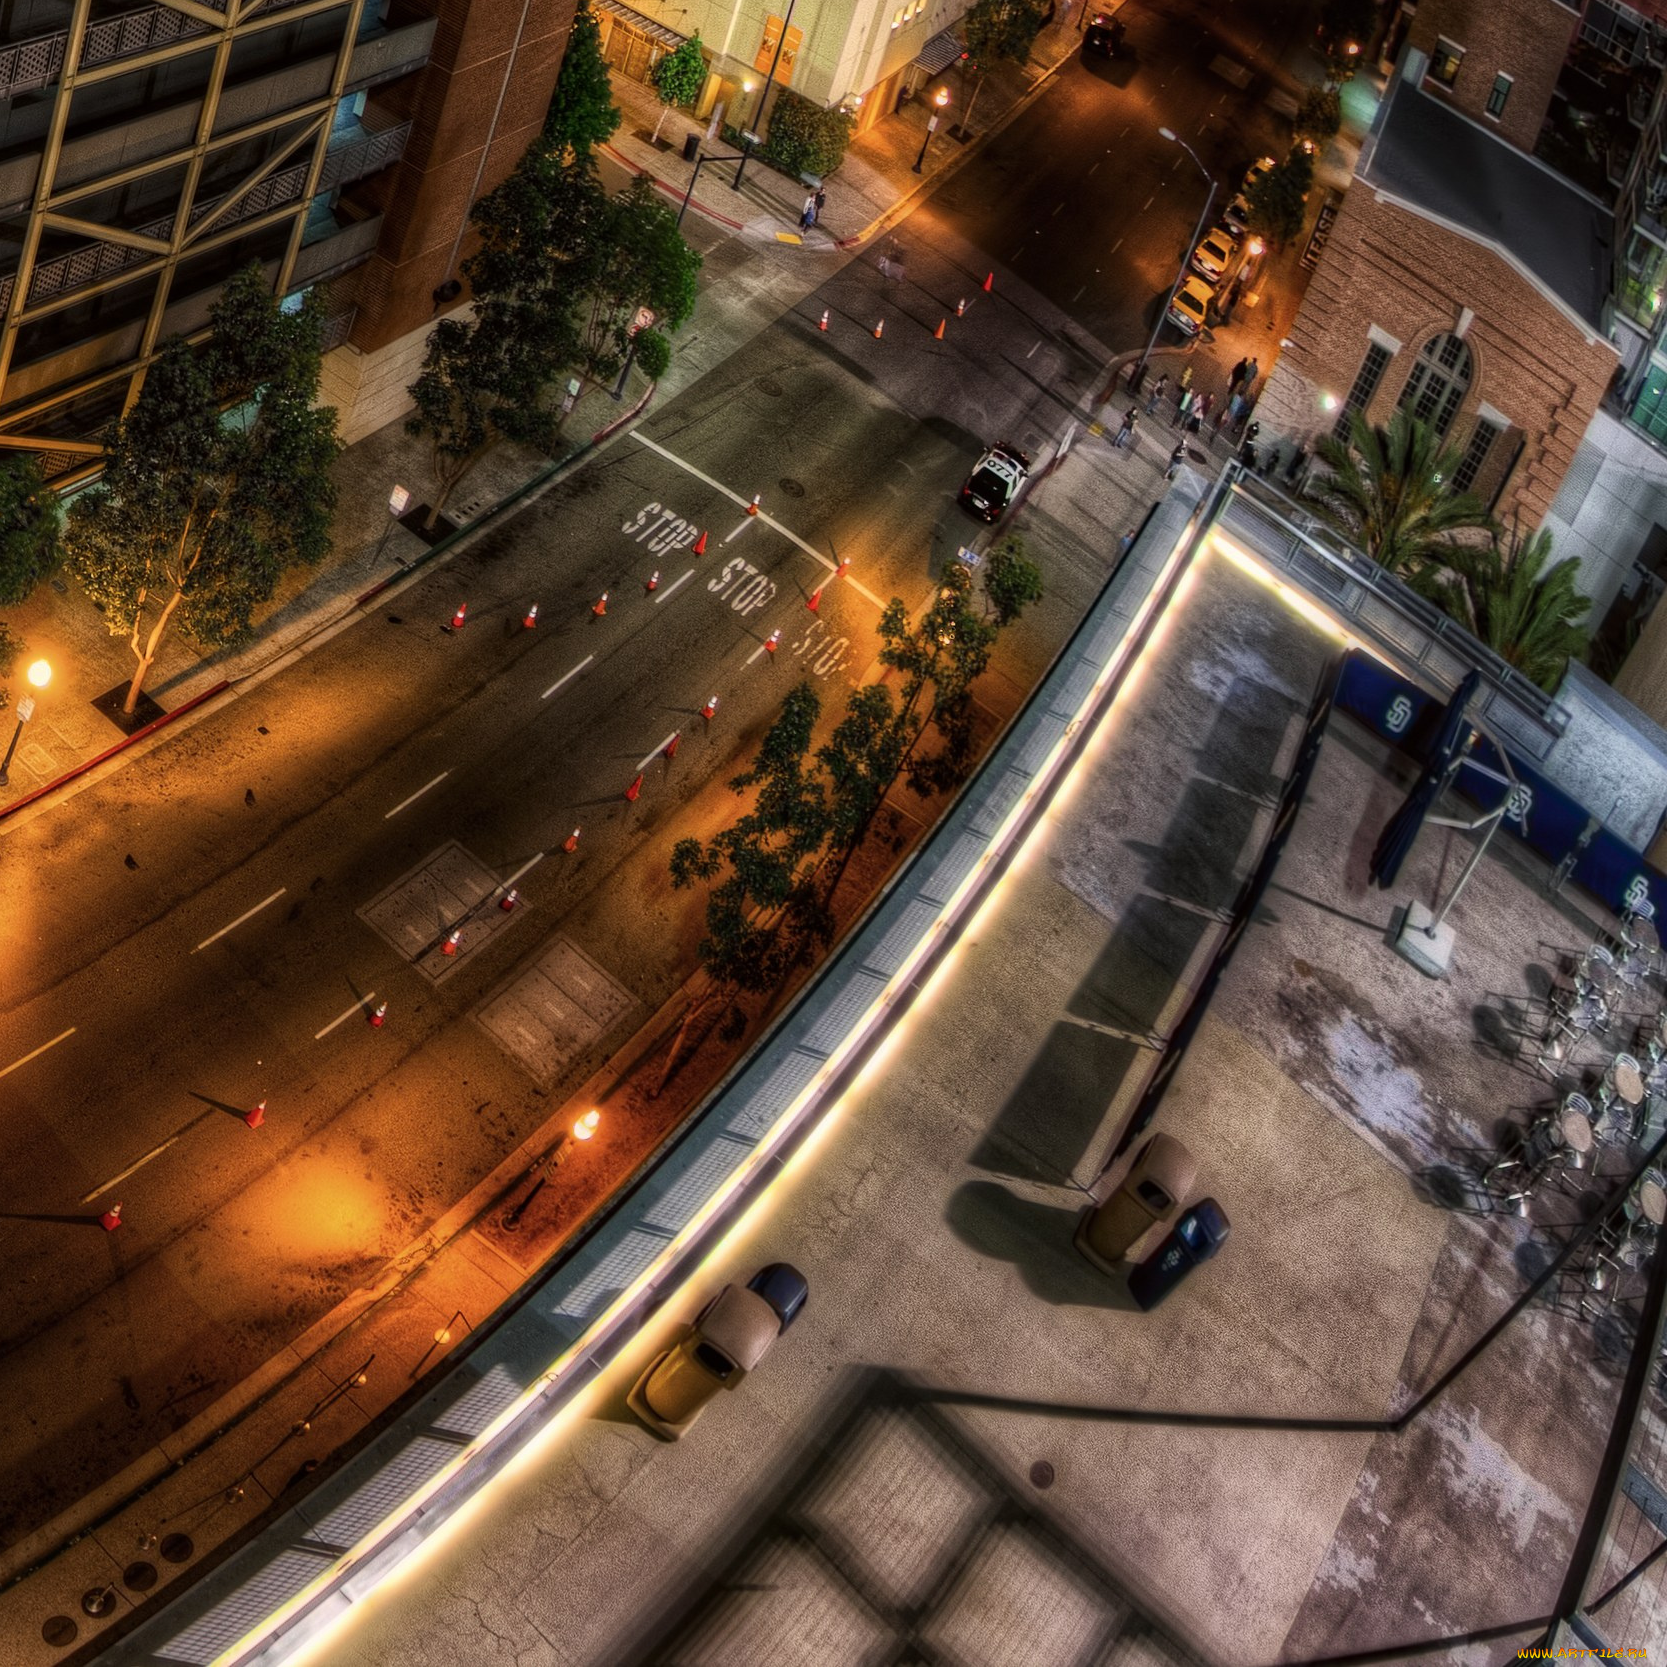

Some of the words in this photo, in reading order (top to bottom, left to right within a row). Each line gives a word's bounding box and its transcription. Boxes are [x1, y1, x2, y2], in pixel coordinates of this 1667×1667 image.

[987, 459, 1013, 479] 077
[622, 502, 698, 557] STOP
[708, 557, 776, 616] STOP
